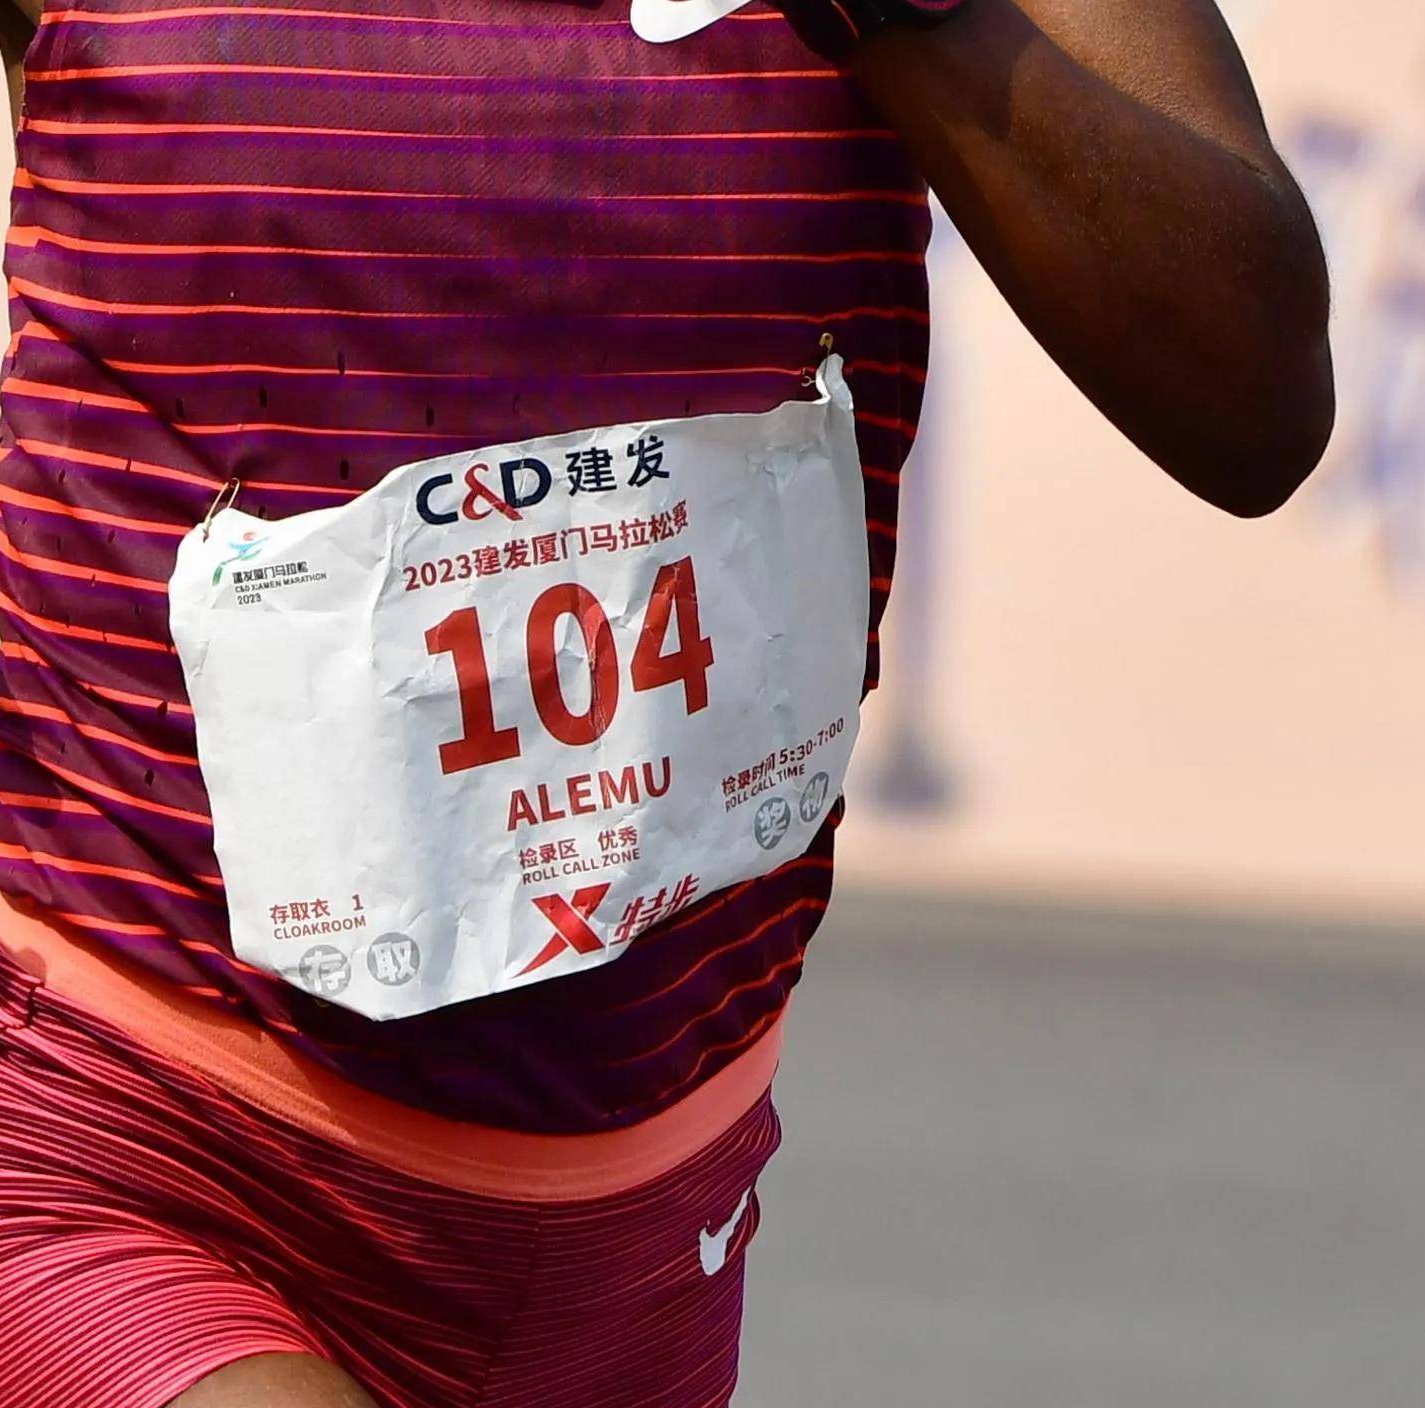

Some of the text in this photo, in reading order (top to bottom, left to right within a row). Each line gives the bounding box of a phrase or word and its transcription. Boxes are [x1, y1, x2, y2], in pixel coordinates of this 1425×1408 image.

[416, 435, 670, 525] C&D 建发
[403, 499, 688, 591] 2023建发厦门马拉松赛
[237, 593, 262, 605] 2023
[251, 579, 282, 592] XIAMEN
[283, 573, 327, 586] MARATHON
[424, 556, 714, 774] 104
[722, 718, 844, 797] 检录时间 5:30-7:00
[507, 756, 671, 831] ALEMU
[725, 764, 805, 813] ROLL CALL TIME
[519, 826, 638, 869] 检录区 优秀
[524, 847, 641, 885] ROLL CALL ZONE
[269, 894, 364, 924] 存取衣 1
[274, 915, 366, 940] CLOAKROOM
[304, 941, 416, 992] 存 取
